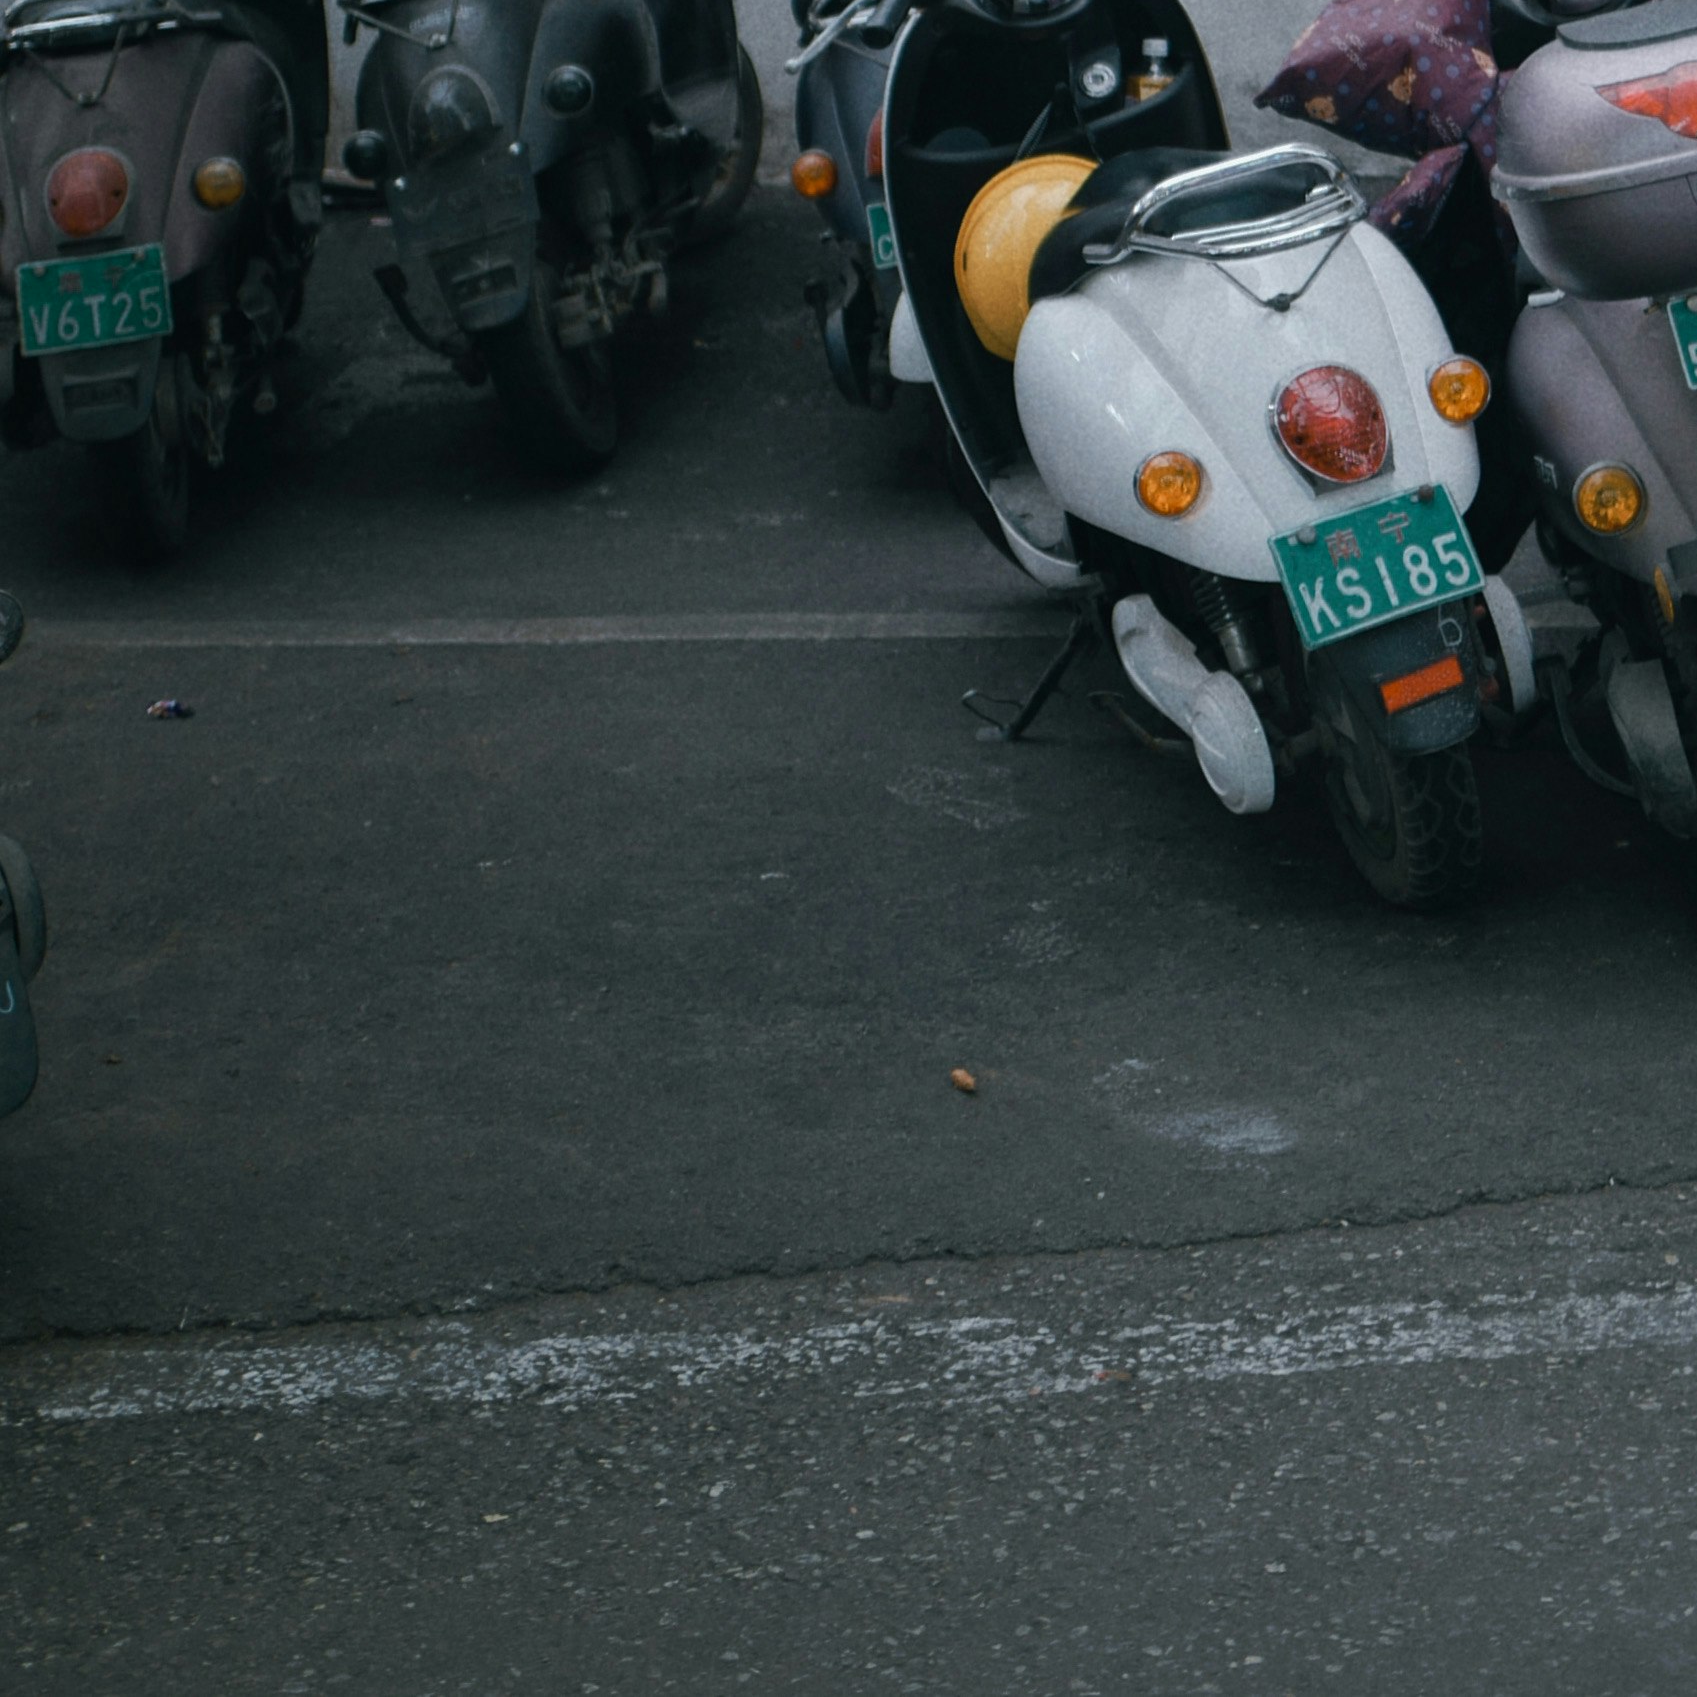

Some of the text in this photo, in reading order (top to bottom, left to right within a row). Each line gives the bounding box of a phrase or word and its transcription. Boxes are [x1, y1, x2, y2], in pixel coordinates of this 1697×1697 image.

[29, 286, 163, 345] V6T25
[1323, 511, 1411, 569] 南宁
[1298, 530, 1471, 635] KS185
